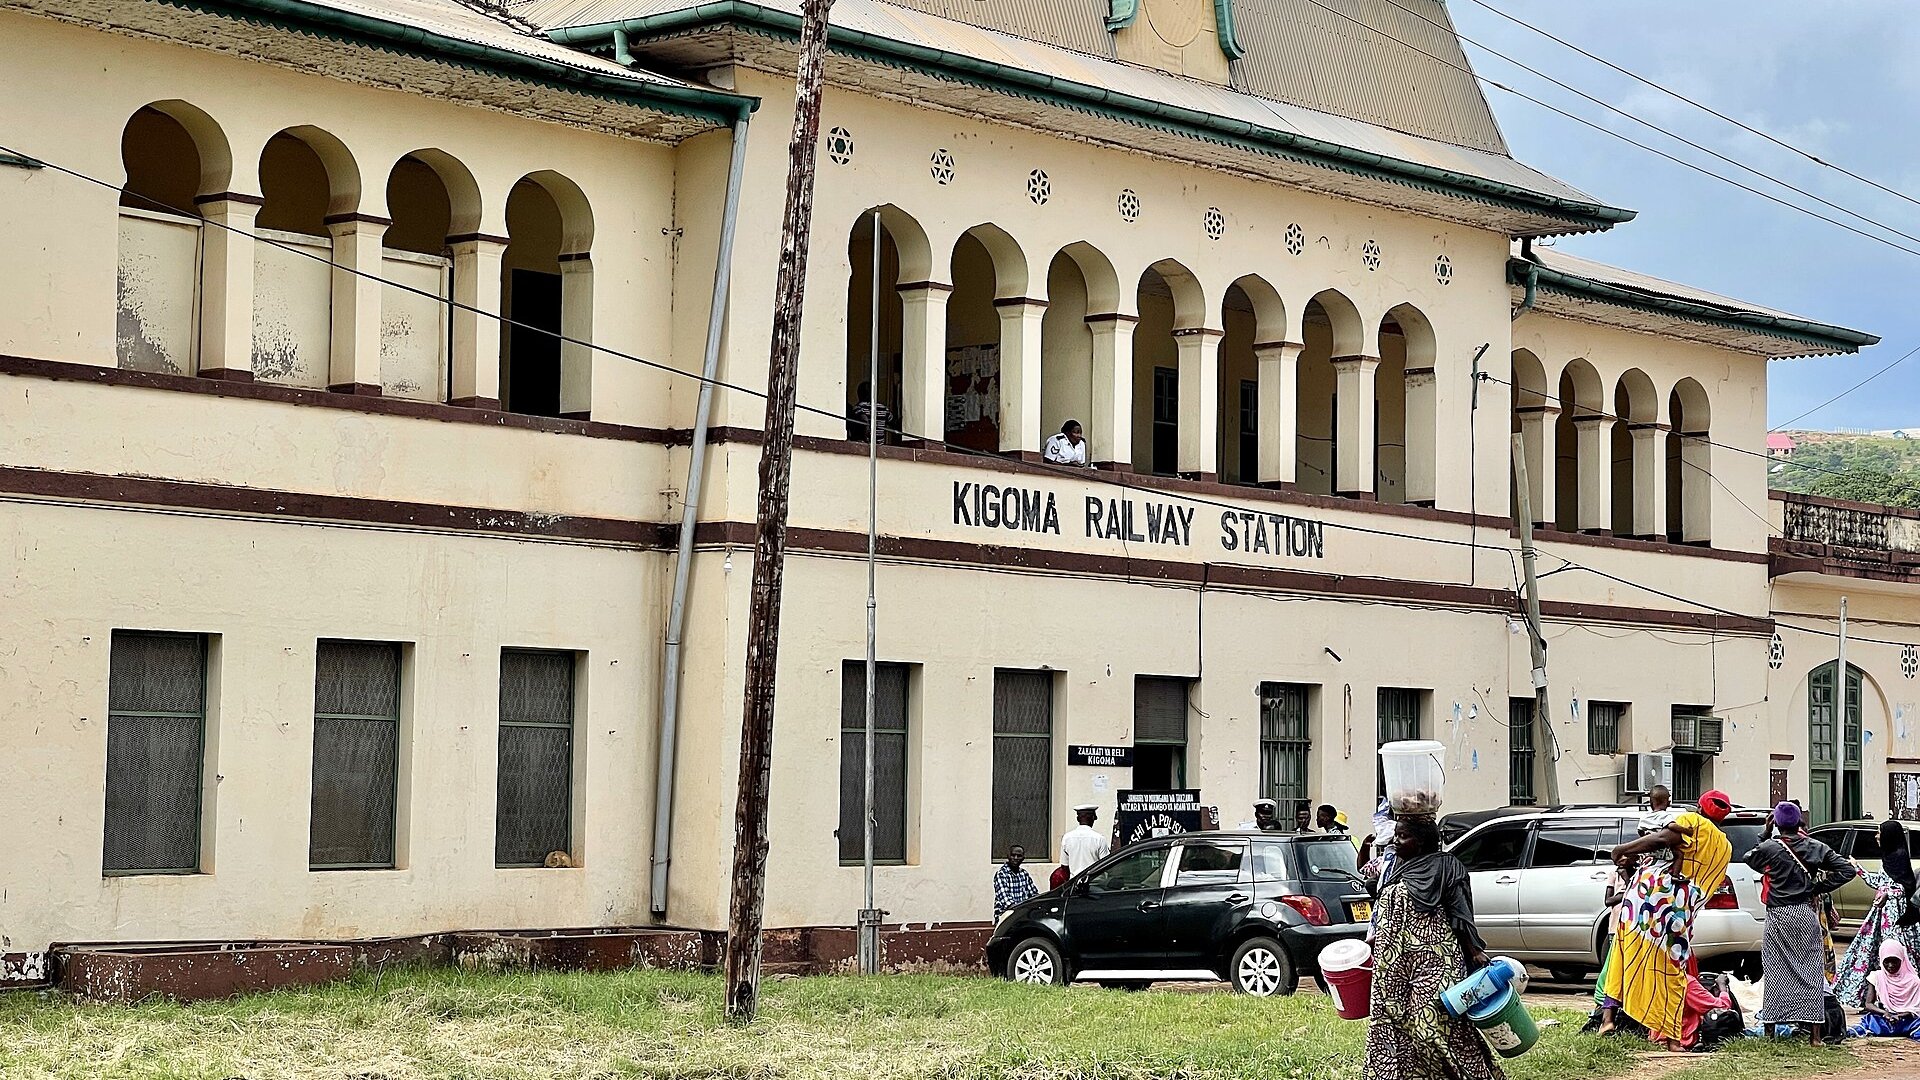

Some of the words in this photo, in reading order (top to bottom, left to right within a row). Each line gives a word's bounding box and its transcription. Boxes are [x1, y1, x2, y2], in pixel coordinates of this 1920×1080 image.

[953, 481, 1061, 535] KIGOMA
[1085, 496, 1195, 546] RAILWAY
[1220, 510, 1324, 559] STATION
[1087, 756, 1116, 766] KIGOMA
[1111, 748, 1125, 757] RELI
[1128, 824, 1145, 845] SHI
[1144, 814, 1158, 831] LA
[1159, 813, 1182, 834] POLISI
